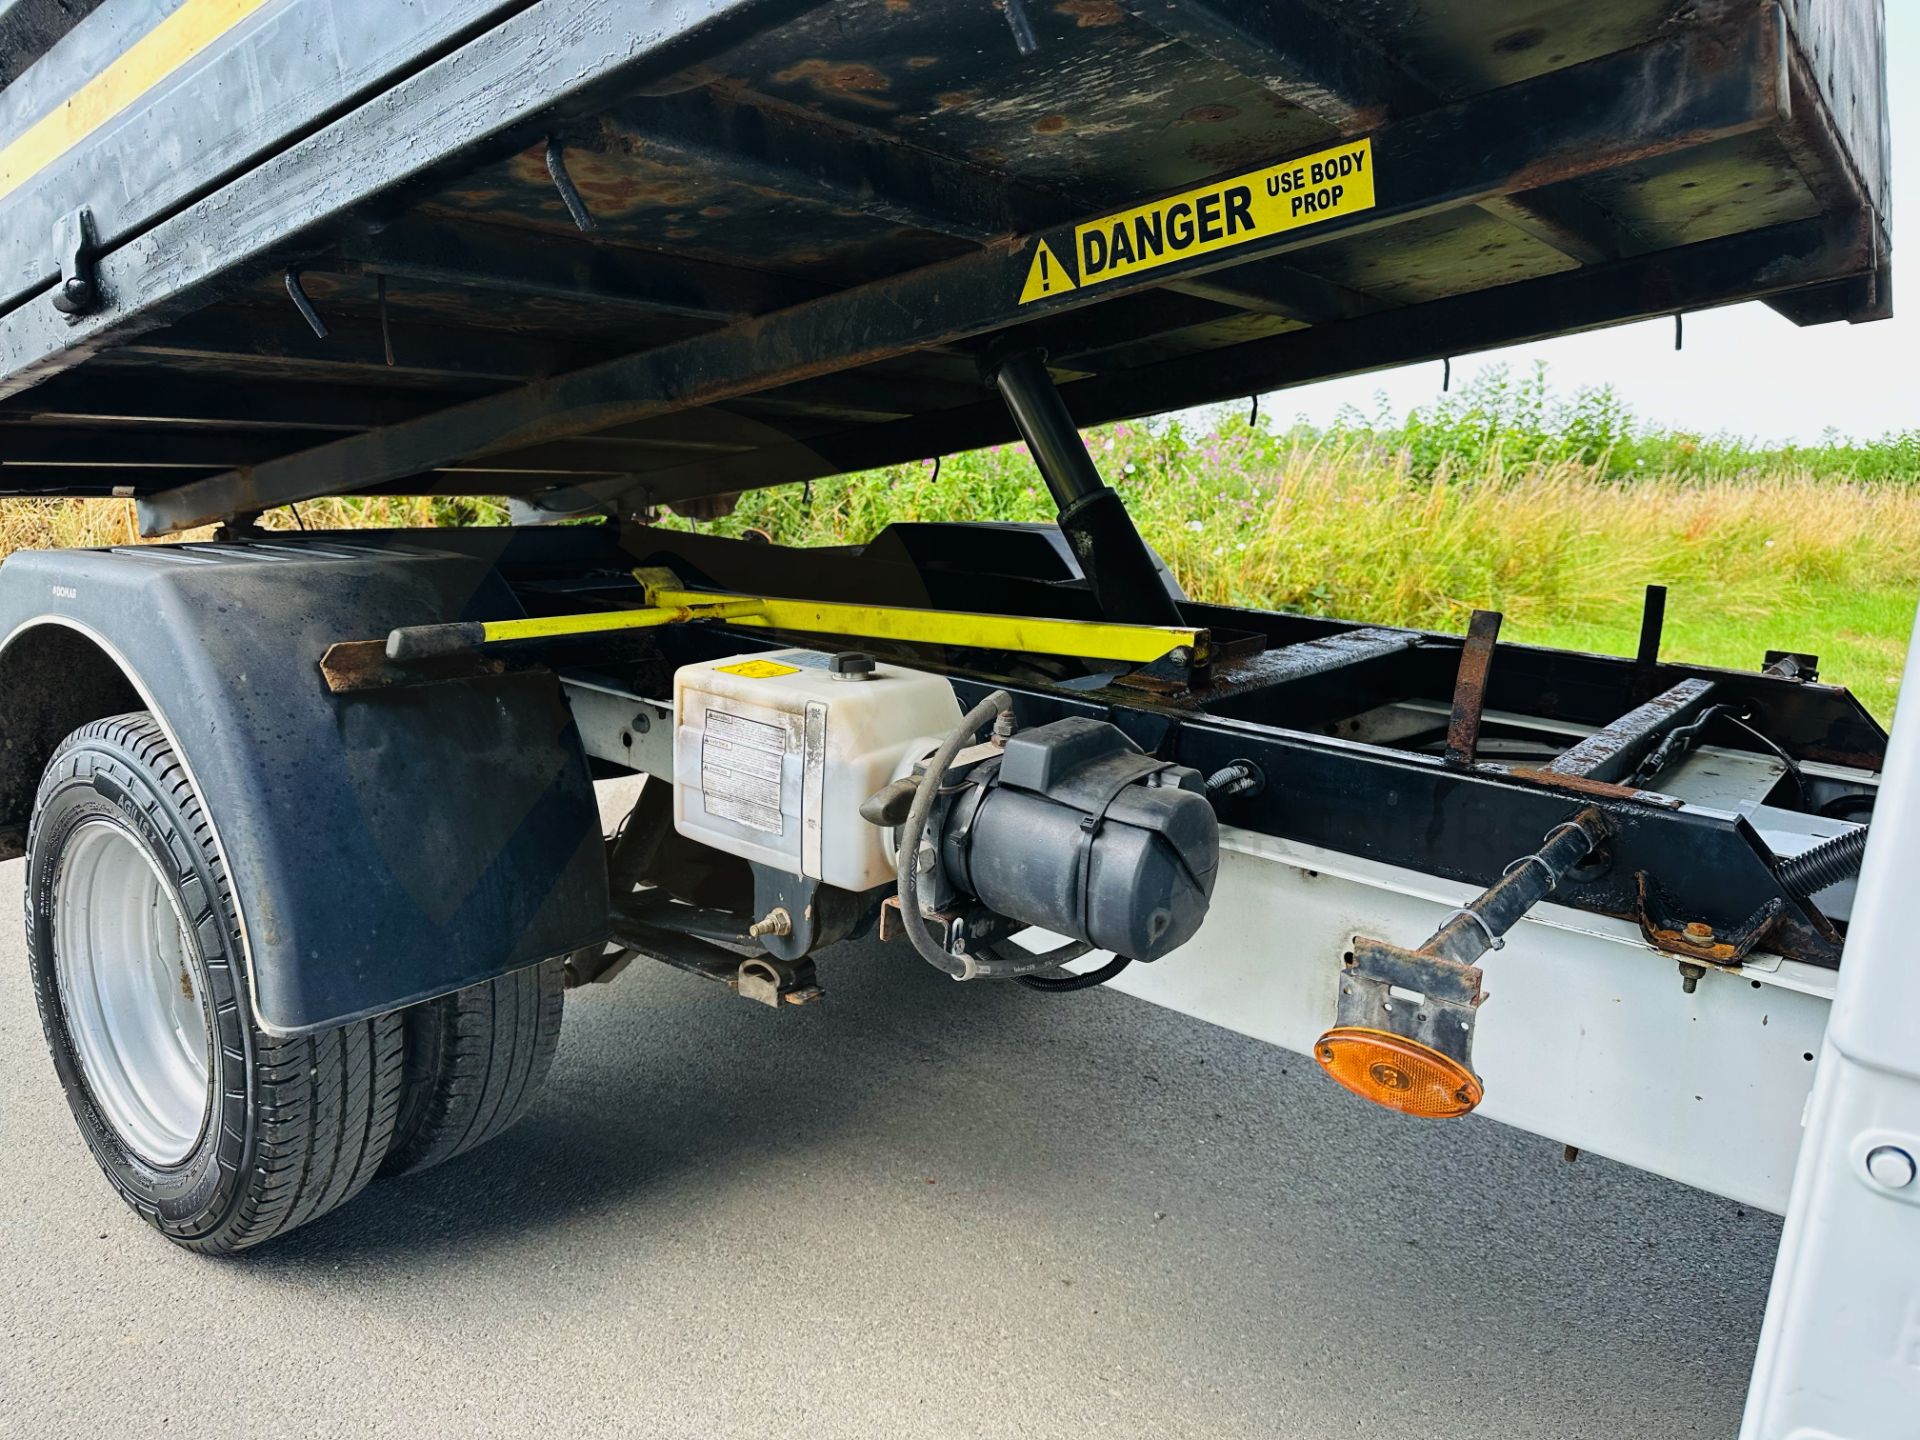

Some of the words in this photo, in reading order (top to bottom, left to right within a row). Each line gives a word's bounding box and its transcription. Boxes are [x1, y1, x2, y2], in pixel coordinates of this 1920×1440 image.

[1267, 169, 1305, 196] USE
[1311, 151, 1365, 183] BODY
[1291, 185, 1344, 217] PROP
[1083, 186, 1255, 275] DANGER
[117, 794, 150, 836] AGILIS
